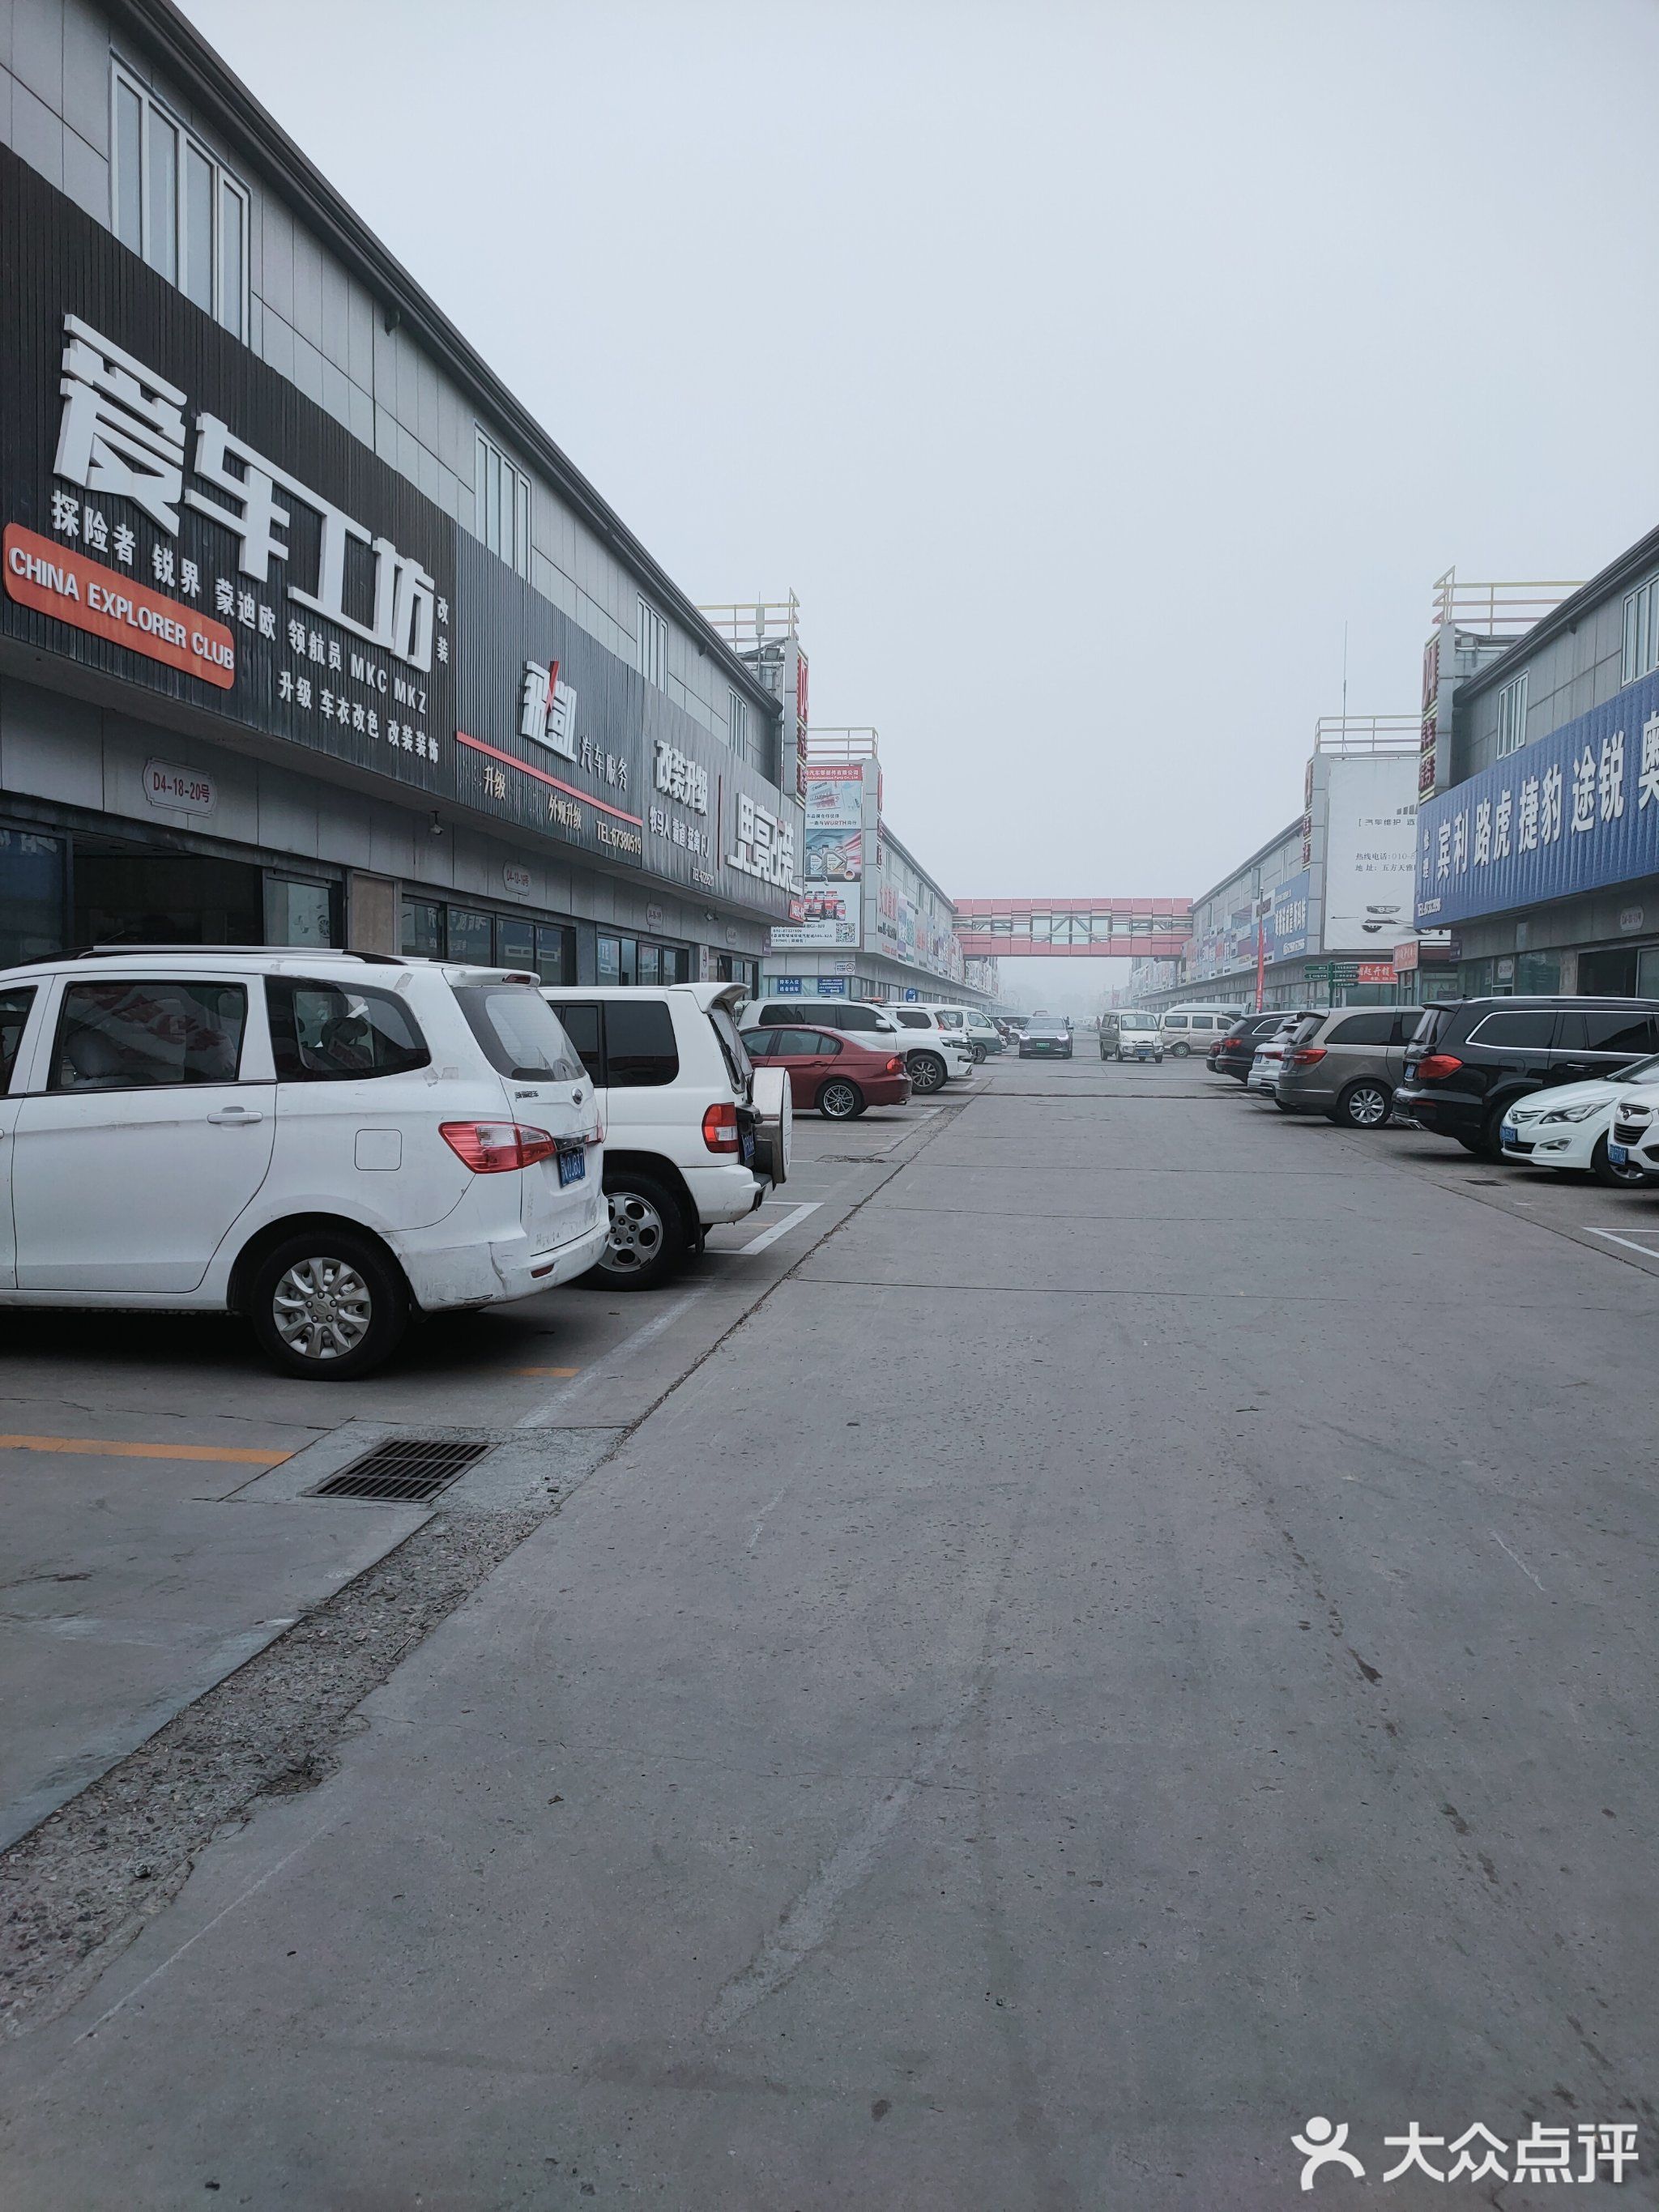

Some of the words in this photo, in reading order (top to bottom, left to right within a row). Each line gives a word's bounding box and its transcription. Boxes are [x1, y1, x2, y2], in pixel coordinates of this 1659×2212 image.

[53, 313, 435, 673] 爱车工坊
[9, 547, 80, 601] CHINA
[87, 582, 186, 650] EXPLORER
[191, 630, 234, 671] CLUB
[50, 489, 136, 566] 探险者
[151, 543, 201, 599] 锐界
[214, 578, 276, 642] 蒙迪欧
[288, 619, 343, 673] 领航员
[351, 653, 387, 693] MKC
[394, 676, 427, 714] MKZ
[436, 595, 450, 666] 改装
[278, 671, 313, 710] 升级
[319, 688, 379, 739] 车衣改色
[386, 718, 439, 765] 改装装饰
[152, 771, 210, 803] D4-18-20号
[483, 765, 505, 801] 升级
[580, 734, 628, 791] 汽车服务
[655, 739, 708, 816] 改装升级
[548, 794, 582, 831] 外观升级
[596, 820, 642, 855] TEL:67380519
[649, 806, 670, 839] 牧马人
[672, 817, 685, 847] 霸道
[687, 825, 700, 854] 猛禽
[1437, 808, 1468, 881] 宾利
[1473, 790, 1511, 867] 路虎
[1519, 764, 1563, 855] 捷豹
[1570, 731, 1625, 832] 途锐
